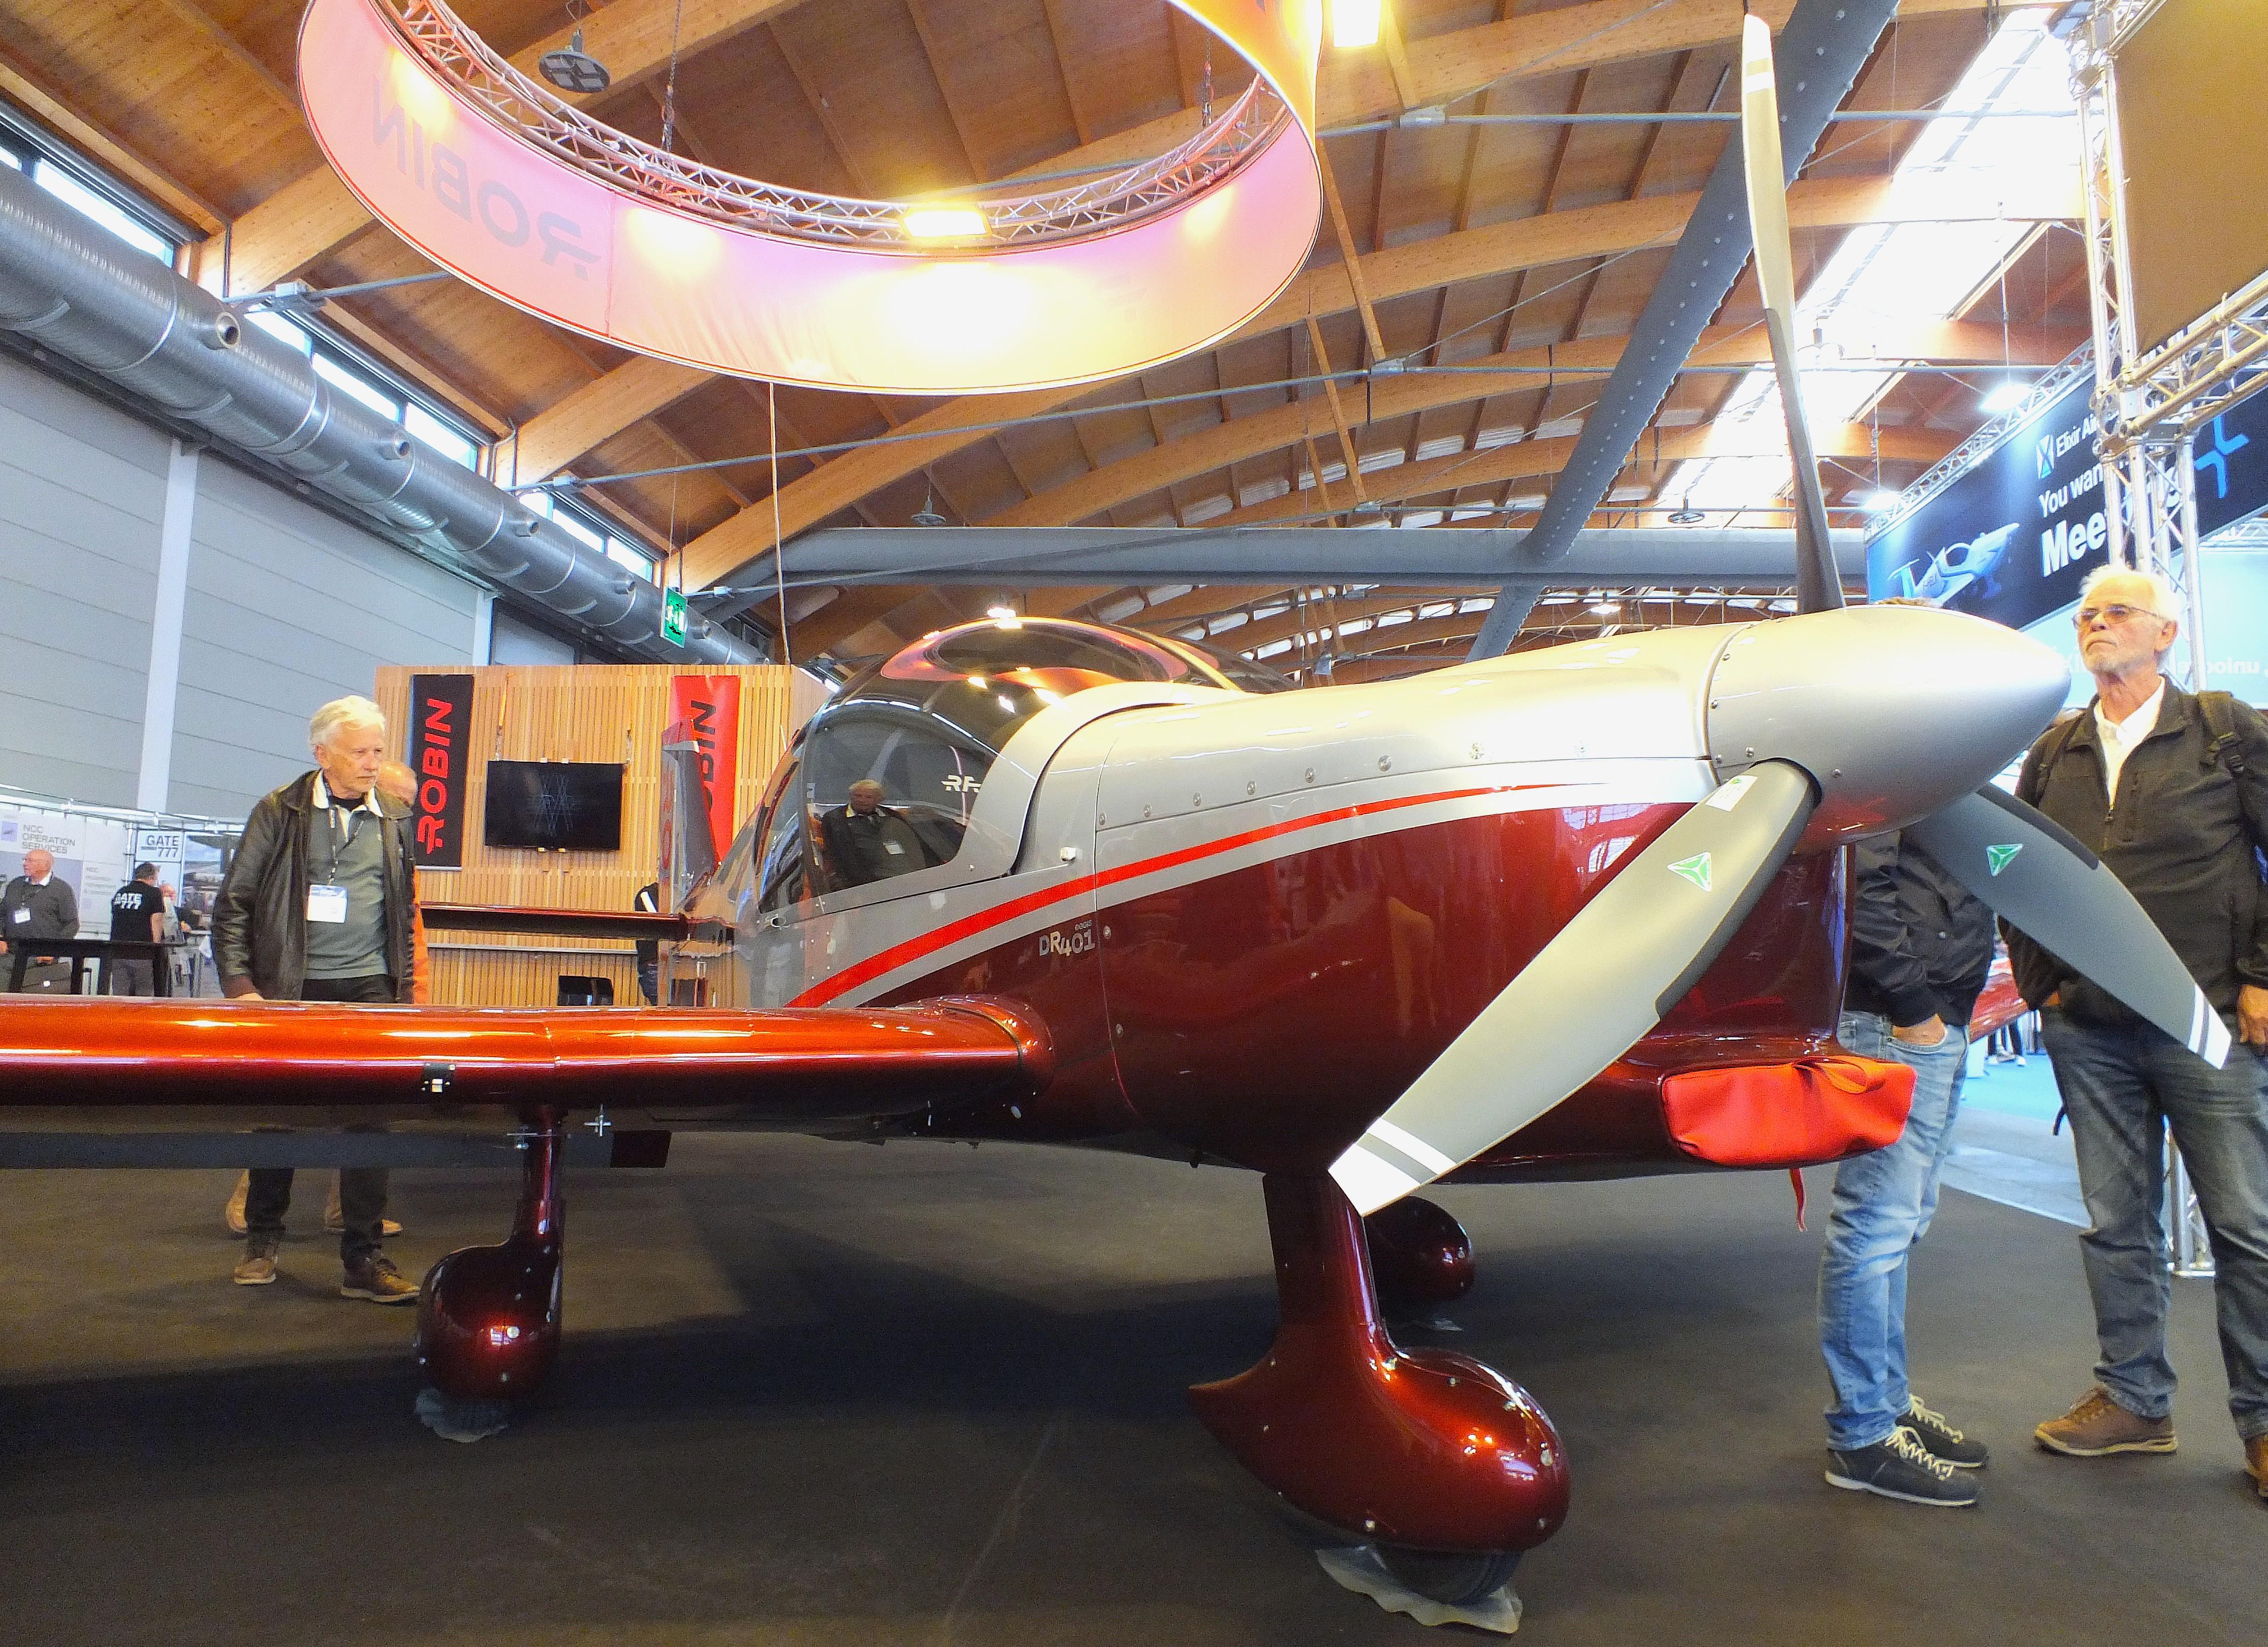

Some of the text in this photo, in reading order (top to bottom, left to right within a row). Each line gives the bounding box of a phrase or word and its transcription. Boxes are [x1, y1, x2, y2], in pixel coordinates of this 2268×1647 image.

[2056, 425, 2081, 457] Elixir
[2039, 462, 2104, 518] You wan
[2041, 512, 2107, 578] Mee
[417, 698, 453, 855] ROBIN
[23, 824, 44, 833] NCC
[22, 832, 76, 847] OPERATION
[147, 834, 180, 846] GATE
[158, 847, 178, 857] 777
[115, 892, 143, 902] GATE
[120, 901, 140, 910] 777
[1039, 929, 1096, 956] DR401
